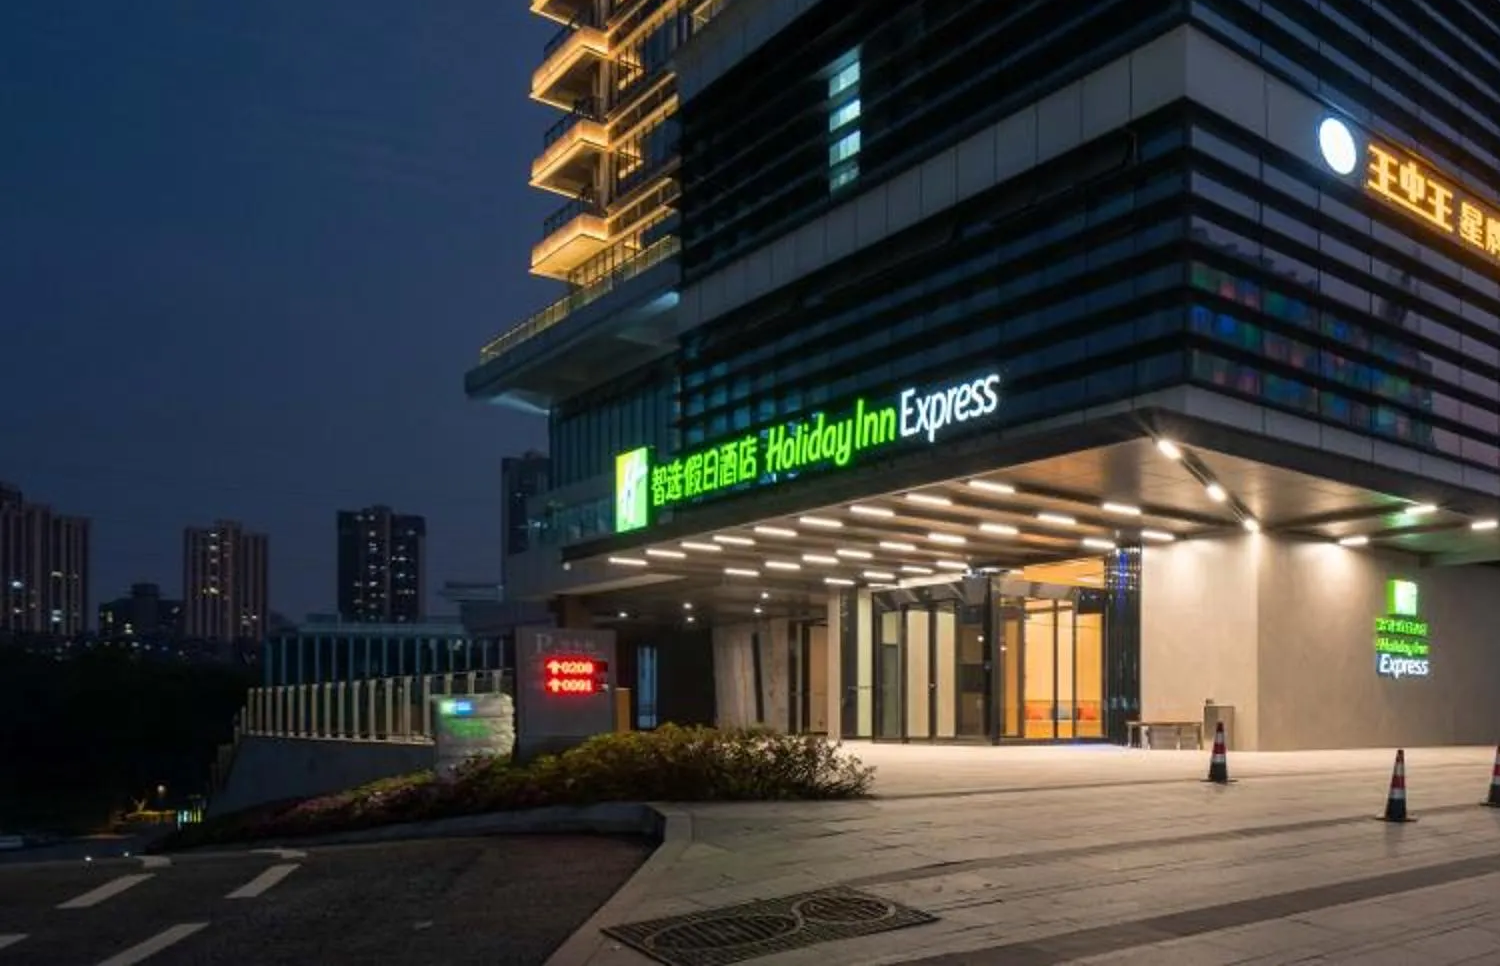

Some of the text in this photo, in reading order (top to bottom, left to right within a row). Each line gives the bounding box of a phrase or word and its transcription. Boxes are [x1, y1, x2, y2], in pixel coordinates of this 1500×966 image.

[651, 374, 1000, 506] 智选假日酒店 Holiday Inn Express
[1379, 653, 1429, 679] Express
